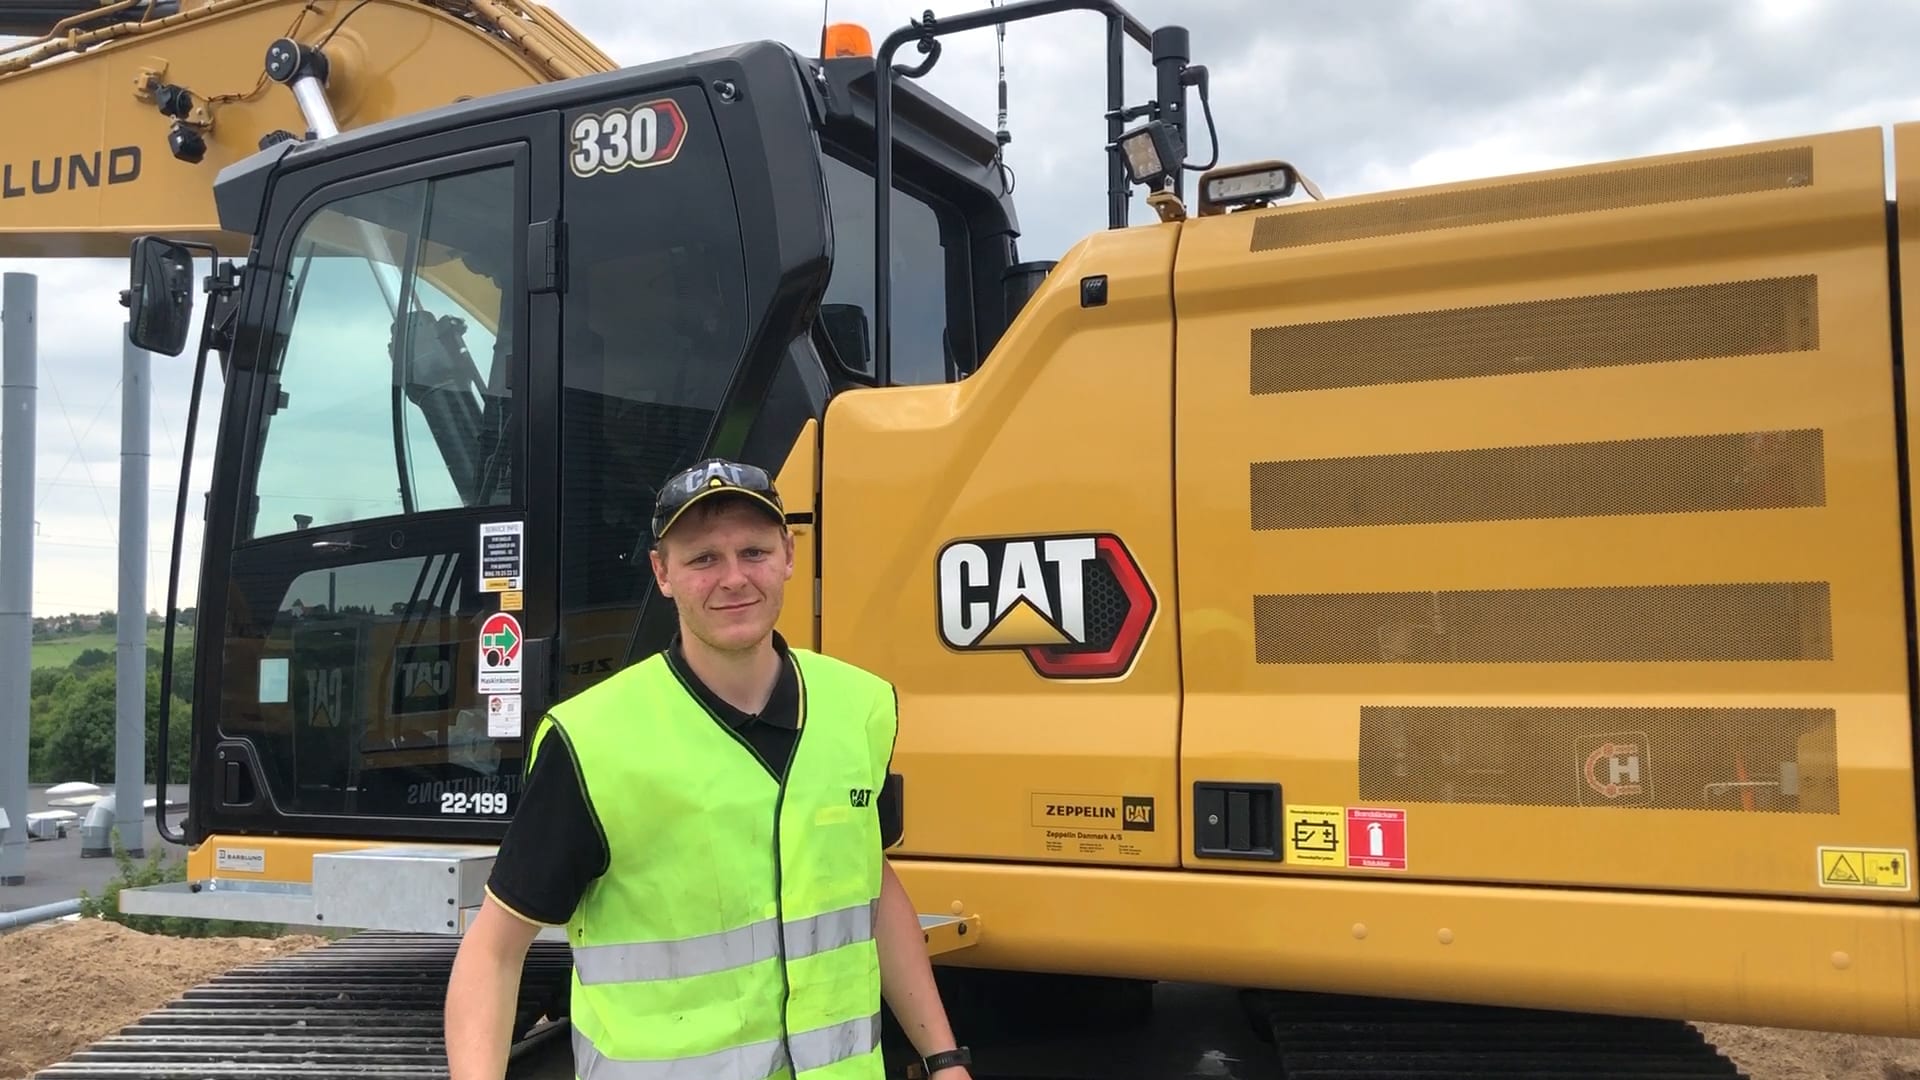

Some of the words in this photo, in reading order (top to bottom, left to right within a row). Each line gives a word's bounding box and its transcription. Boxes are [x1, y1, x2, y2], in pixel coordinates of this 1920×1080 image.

[575, 107, 657, 171] 330
[3, 145, 141, 198] LUND
[685, 462, 743, 493] CAT
[940, 537, 1096, 647] CAT
[440, 793, 508, 815] 22-199
[850, 788, 872, 807] CAT
[1046, 805, 1116, 818] ZEPPELIN
[1125, 805, 1151, 823] CAT
[1046, 830, 1076, 839] Zeppelin
